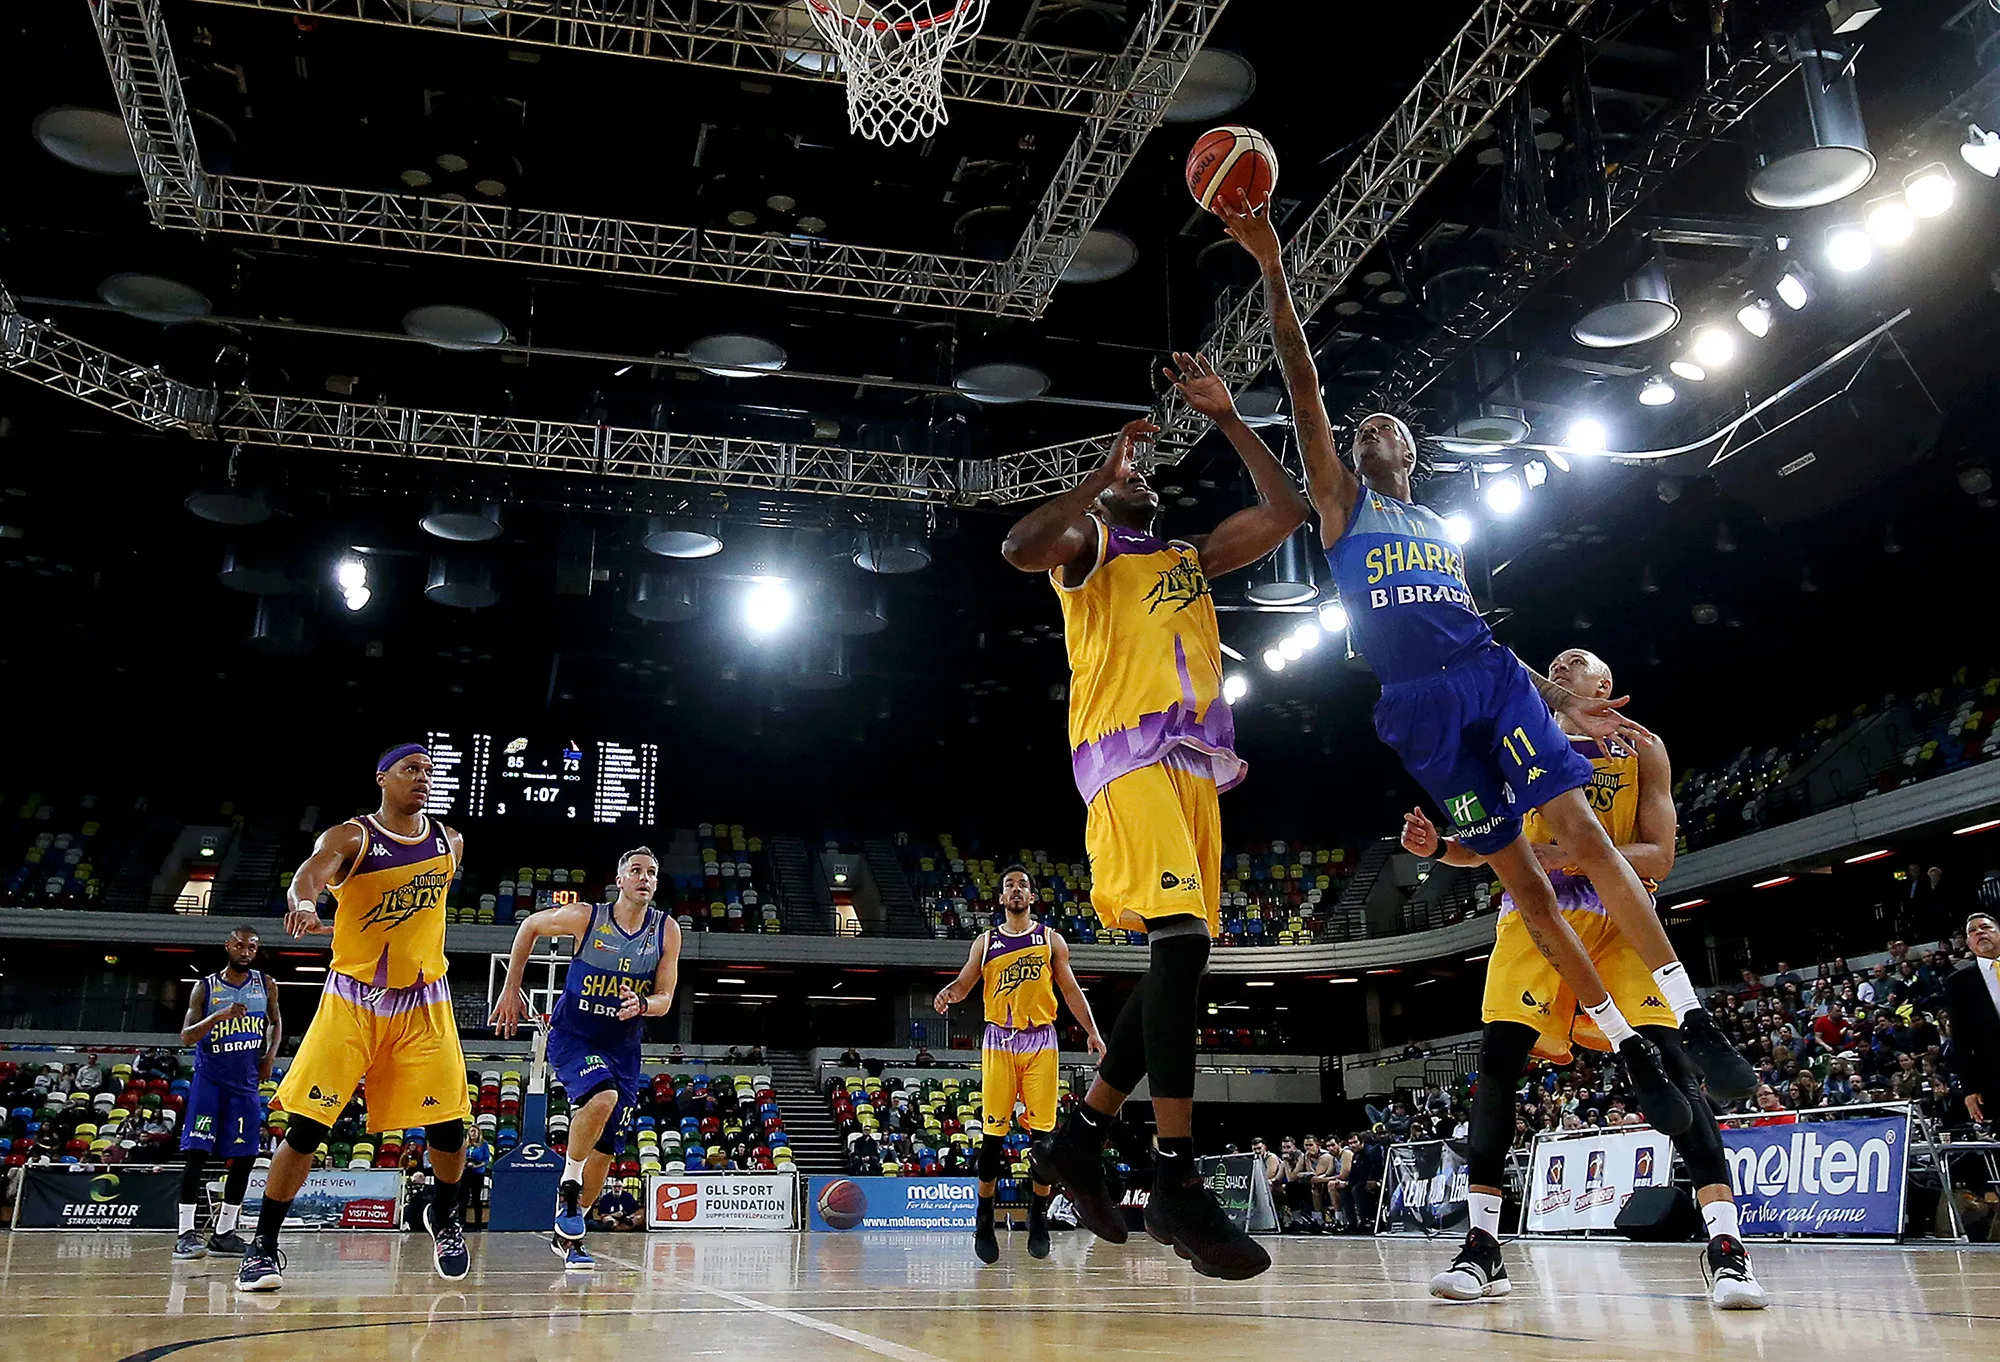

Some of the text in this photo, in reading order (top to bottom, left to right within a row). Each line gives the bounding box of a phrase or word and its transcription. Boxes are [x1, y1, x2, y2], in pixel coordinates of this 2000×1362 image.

[1503, 726, 1537, 766] 11
[507, 756, 524, 769] 85
[563, 759, 579, 771] 73
[1590, 773, 1618, 788] NDON
[523, 787, 560, 802] 1:07
[497, 803, 506, 815] 3
[567, 806, 576, 818] 3
[436, 837, 446, 854] 6
[414, 874, 446, 887] LONDON
[553, 890, 577, 905] 1:07
[1030, 933, 1044, 945] 10
[618, 957, 632, 973] 15
[238, 1117, 244, 1134] 1
[310, 1179, 327, 1187] THE
[330, 1179, 357, 1188] VIEW!
[1225, 1175, 1248, 1190] SHACK
[705, 1185, 774, 1196] GLL SPORT
[907, 1183, 974, 1200] molten
[62, 1203, 140, 1216] ENERTOR
[705, 1199, 785, 1211] FOUNDATION
[906, 1201, 975, 1212] For the real game
[348, 1209, 389, 1219] VISIT NOW
[1739, 1200, 1867, 1232] For the real game
[66, 1217, 86, 1225] STAY
[112, 1217, 132, 1225] FREE
